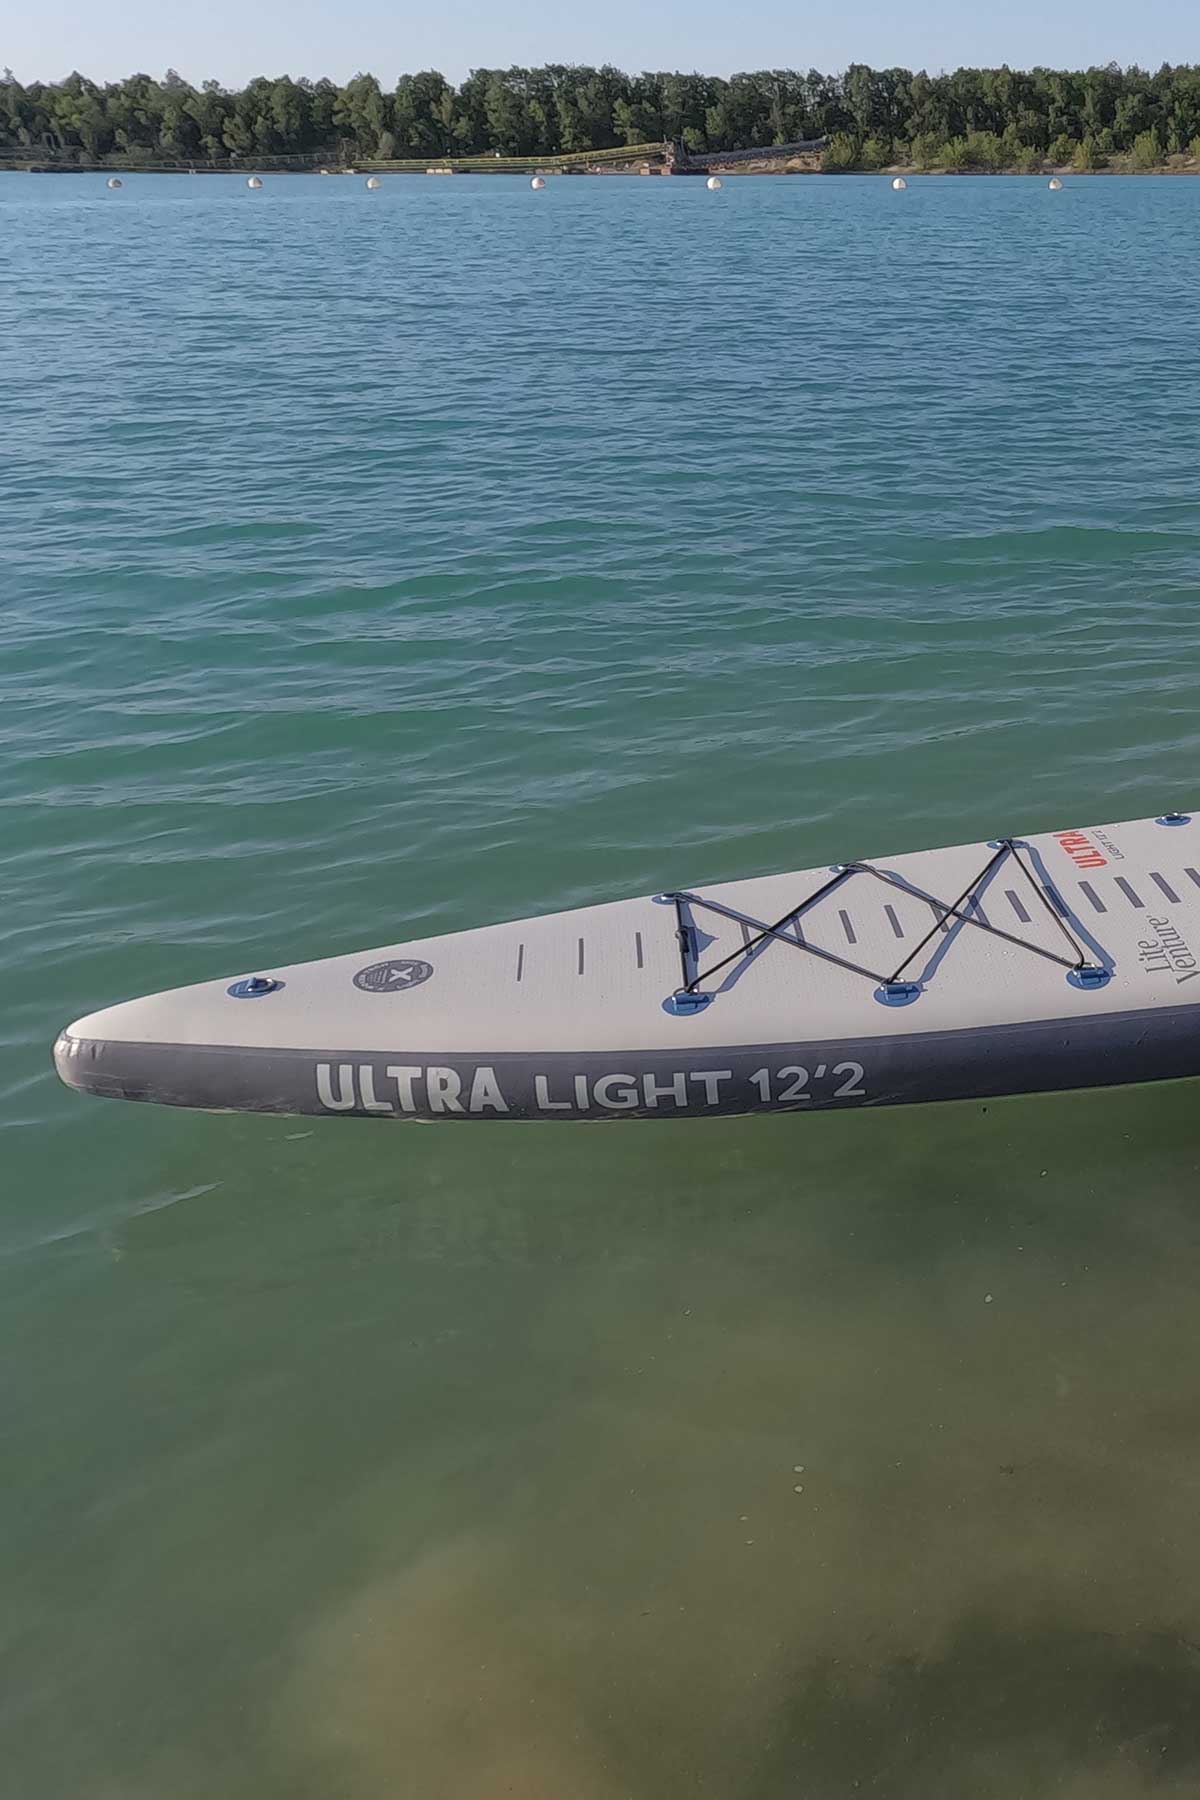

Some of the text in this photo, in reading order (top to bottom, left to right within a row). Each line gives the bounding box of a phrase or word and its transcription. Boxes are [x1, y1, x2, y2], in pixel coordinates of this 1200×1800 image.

[1053, 830, 1108, 869] ULTRA
[1137, 939, 1175, 974] Lite
[1147, 916, 1200, 985] Venture
[315, 1061, 867, 1113] ULTRA LIGHT 12'2
